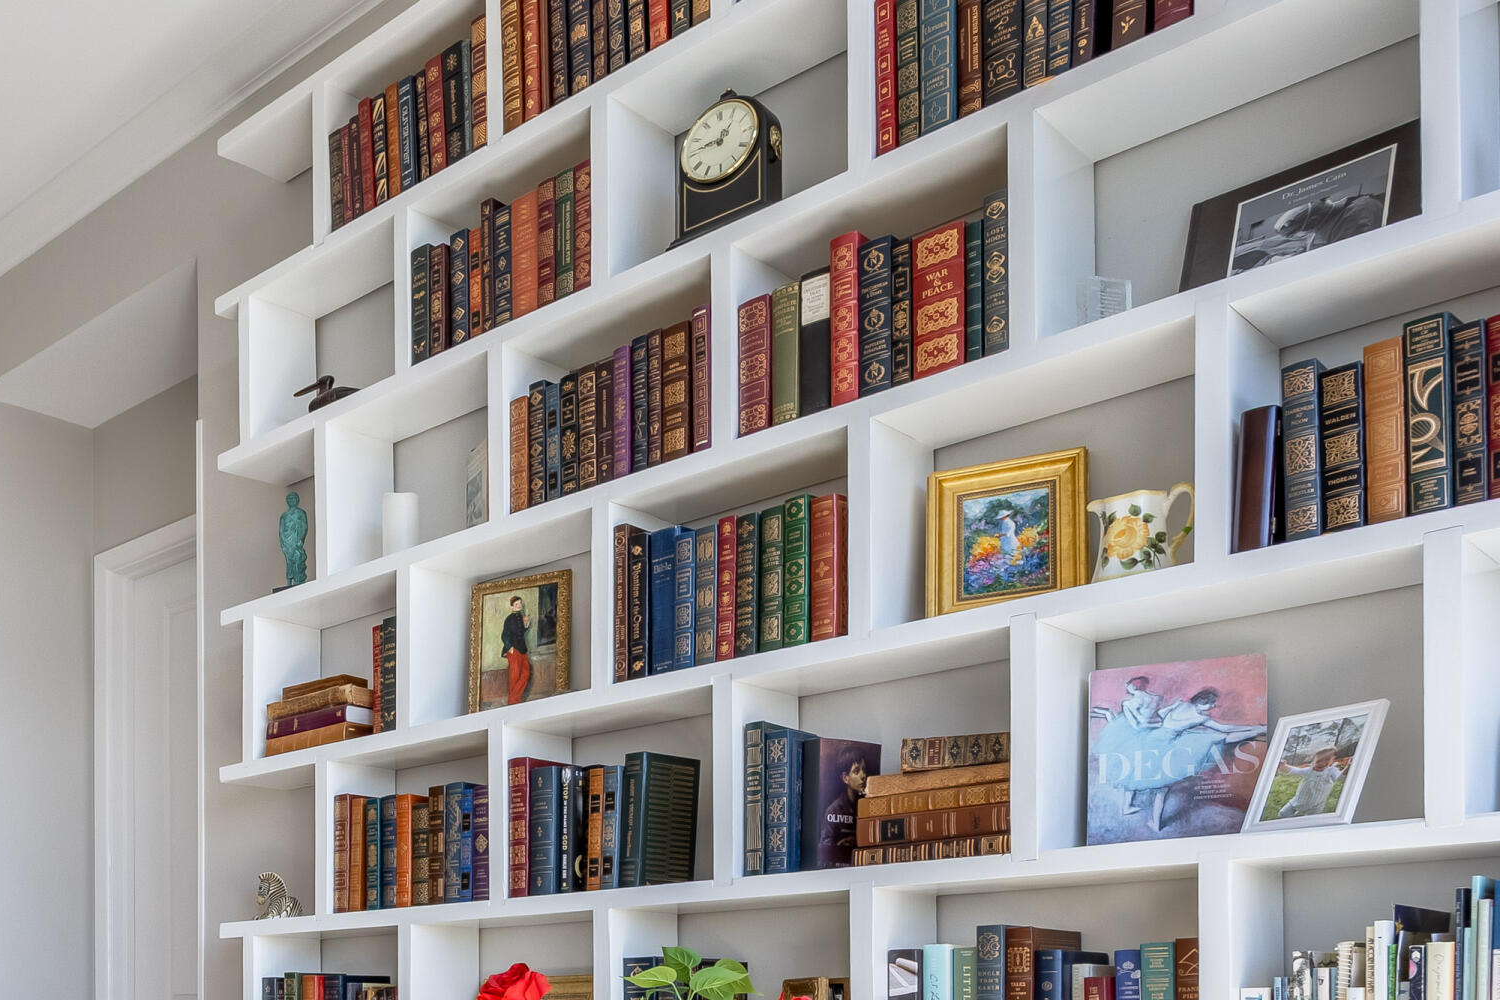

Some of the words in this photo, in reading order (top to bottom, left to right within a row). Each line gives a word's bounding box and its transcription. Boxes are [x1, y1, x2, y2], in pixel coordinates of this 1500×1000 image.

[402, 106, 410, 136] OLIVER
[403, 137, 411, 164] TWIST
[1297, 180, 1323, 195] James
[986, 225, 1004, 236] LOST
[985, 231, 1005, 243] MOON
[925, 268, 948, 280] WAR
[934, 278, 941, 286] &
[922, 282, 954, 299] PEACE
[1284, 404, 1314, 416] DARKNESS
[1290, 417, 1308, 425] NOON
[1324, 412, 1357, 424] WALDEN
[1327, 474, 1357, 485] THOREAU
[653, 562, 672, 574] Bible
[632, 563, 641, 597] Phantom
[633, 615, 642, 639] Opera
[1099, 740, 1262, 785] DEGAS
[827, 813, 854, 824] OLIVER
